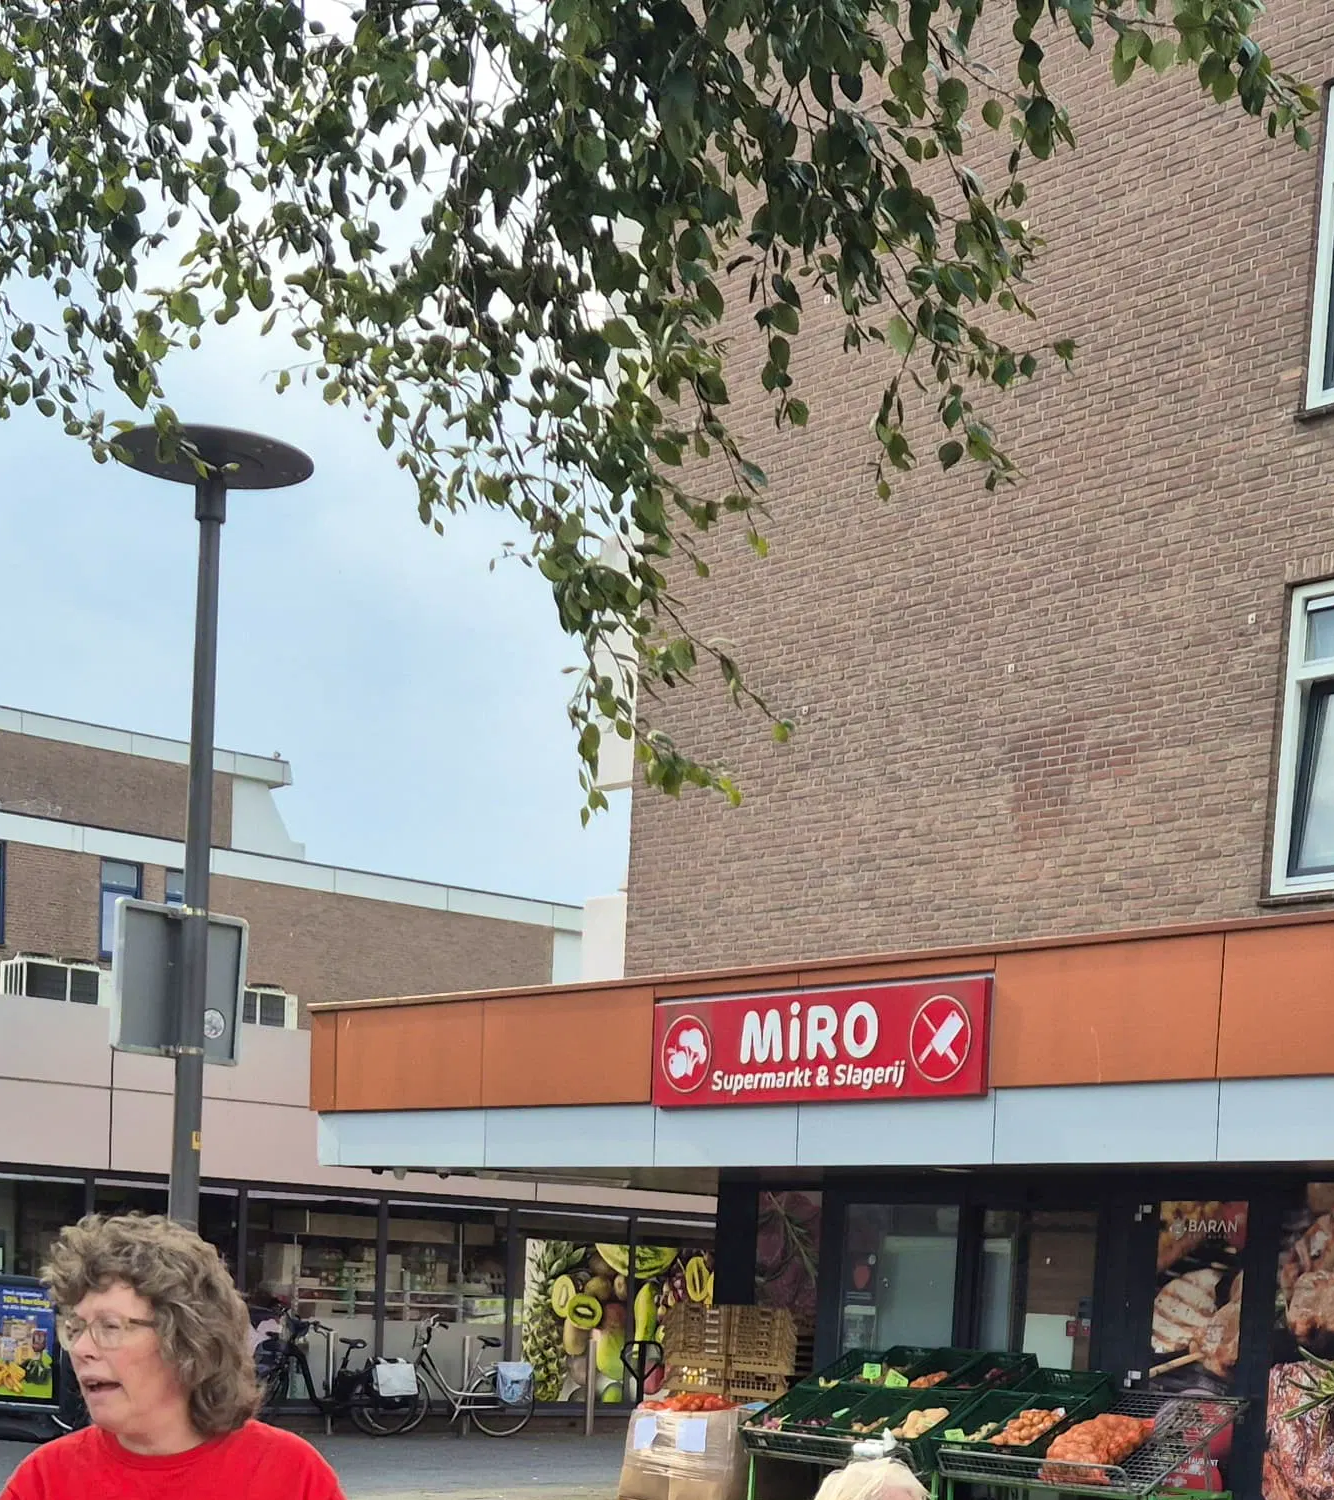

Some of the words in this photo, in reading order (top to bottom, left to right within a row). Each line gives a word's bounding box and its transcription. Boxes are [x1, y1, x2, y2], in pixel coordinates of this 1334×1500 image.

[711, 1066, 813, 1096] Supermarkt
[816, 1064, 830, 1087] &
[833, 1060, 906, 1091] Slagerij
[1188, 1219, 1238, 1233] BARAN
